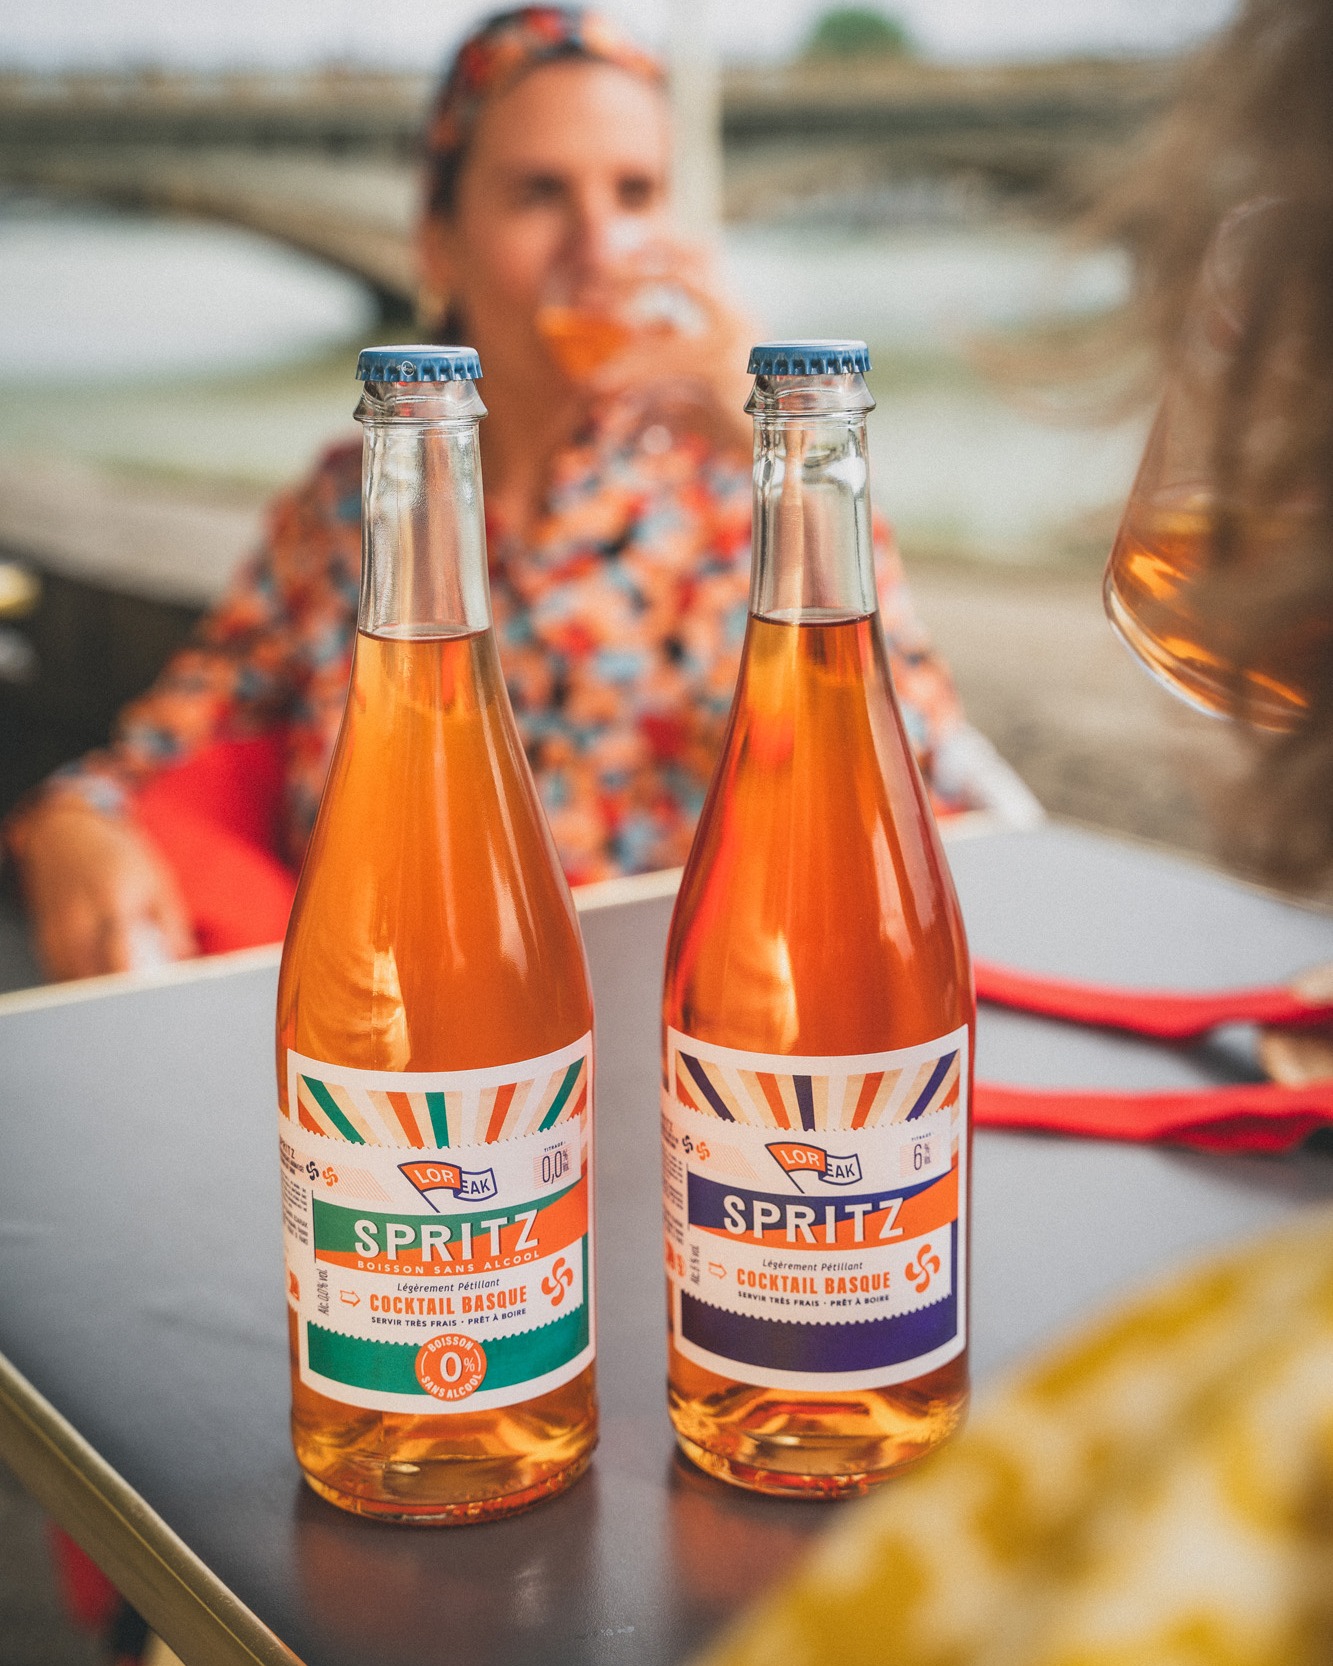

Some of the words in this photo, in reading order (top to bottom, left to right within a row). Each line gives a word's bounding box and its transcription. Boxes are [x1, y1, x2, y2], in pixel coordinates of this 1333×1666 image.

[723, 1194, 904, 1244] SPRITZ
[354, 1209, 539, 1262] SPRITZ
[357, 1260, 424, 1274] BOISSON
[434, 1263, 474, 1274] SANS
[484, 1250, 540, 1270] ALCOOL
[762, 1259, 817, 1271] Légèrement
[821, 1261, 863, 1271] Pétillant
[397, 1282, 454, 1294] Légèrement
[458, 1278, 500, 1291] Pétillant
[736, 1268, 818, 1294] COCKTAIL
[825, 1271, 890, 1294] BASQUE
[369, 1293, 455, 1316] COCKTAIL
[462, 1285, 527, 1314] BASQUE
[738, 1290, 766, 1302] SERVIR
[769, 1295, 791, 1305] TRÈS
[830, 1298, 851, 1306] PRÊT
[855, 1296, 861, 1305] À
[864, 1294, 889, 1304] BOIRE
[371, 1316, 402, 1326] SERVIR
[405, 1318, 427, 1327] TRÈS
[468, 1315, 490, 1325] PRÊT
[493, 1313, 499, 1321] À
[502, 1308, 527, 1320] BOIRE
[427, 1336, 474, 1353] BOISSON
[440, 1351, 475, 1383] 0%
[421, 1376, 446, 1397] SANS
[446, 1374, 482, 1399] ALCOOL
